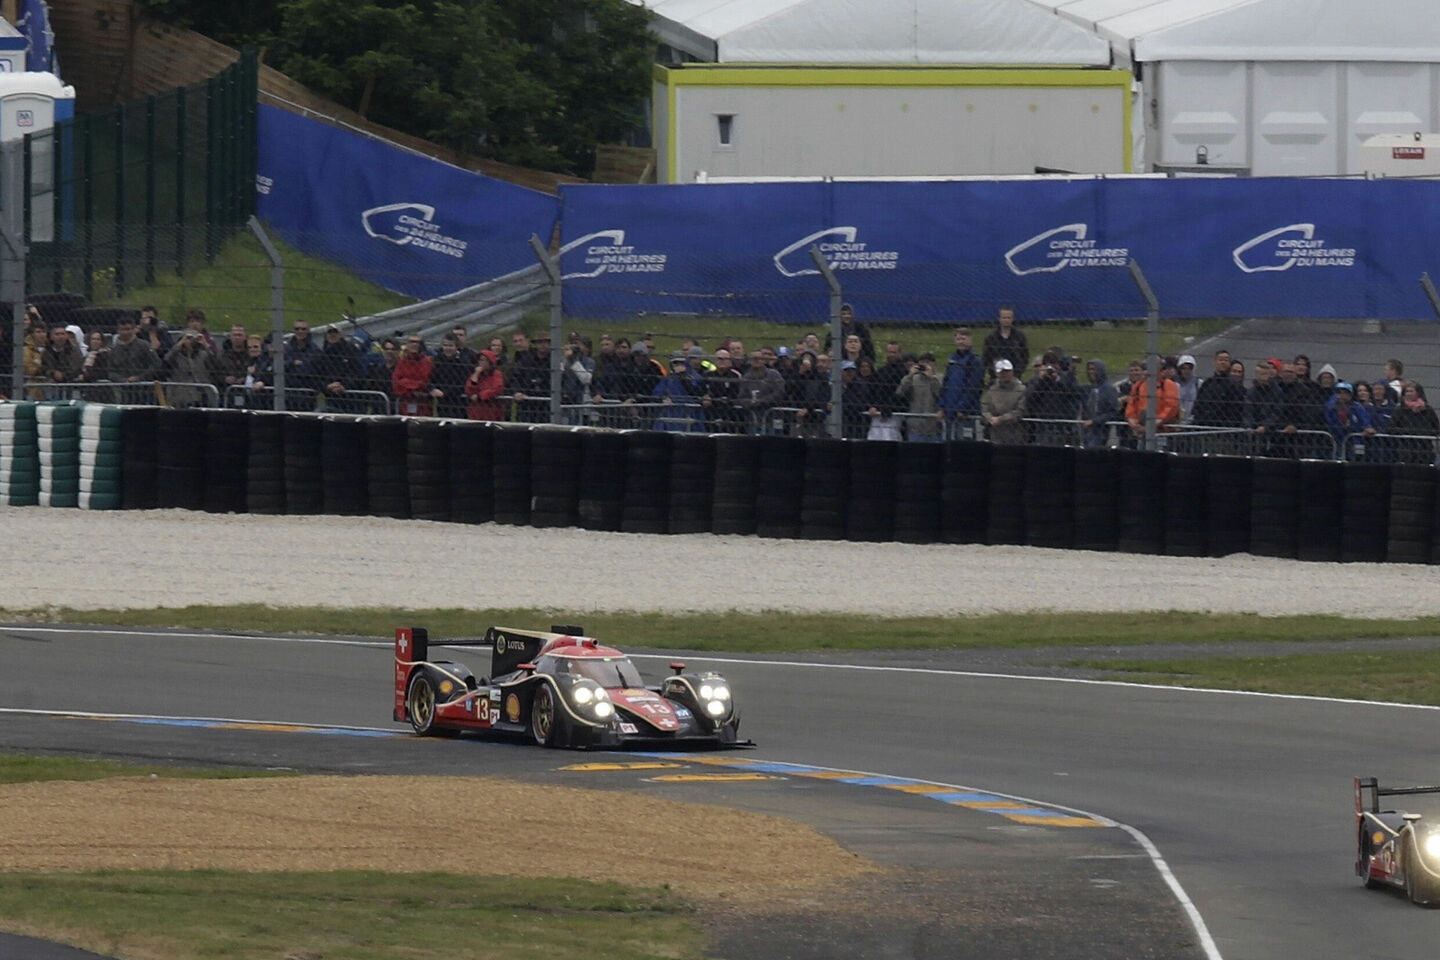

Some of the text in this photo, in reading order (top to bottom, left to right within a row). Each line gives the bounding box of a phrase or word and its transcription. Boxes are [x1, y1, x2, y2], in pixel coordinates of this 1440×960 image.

[398, 215, 441, 232] CIRCUIT
[409, 227, 425, 237] 24
[425, 231, 468, 250] HEURES
[412, 237, 464, 258] DU MANS
[820, 243, 866, 252] CIRCUIT
[1049, 240, 1096, 249] CIRCUIT
[1278, 240, 1324, 249] CIRCUIT
[588, 246, 635, 255] CIRCUIT
[1064, 249, 1080, 258] 24
[1080, 248, 1129, 257] HEURES
[1292, 248, 1307, 257] 24
[1308, 248, 1356, 257] HEURES
[602, 254, 618, 264] 24
[618, 254, 667, 264] HEURES
[834, 252, 850, 261] 24
[850, 251, 899, 260] HEURES
[840, 261, 897, 270] DU MANS
[1069, 257, 1127, 267] DU MANS
[1296, 257, 1354, 267] DU MANS
[607, 264, 664, 273] DU MANS
[508, 641, 525, 650] LOTUS
[475, 698, 489, 720] 13
[641, 703, 671, 714] 13
